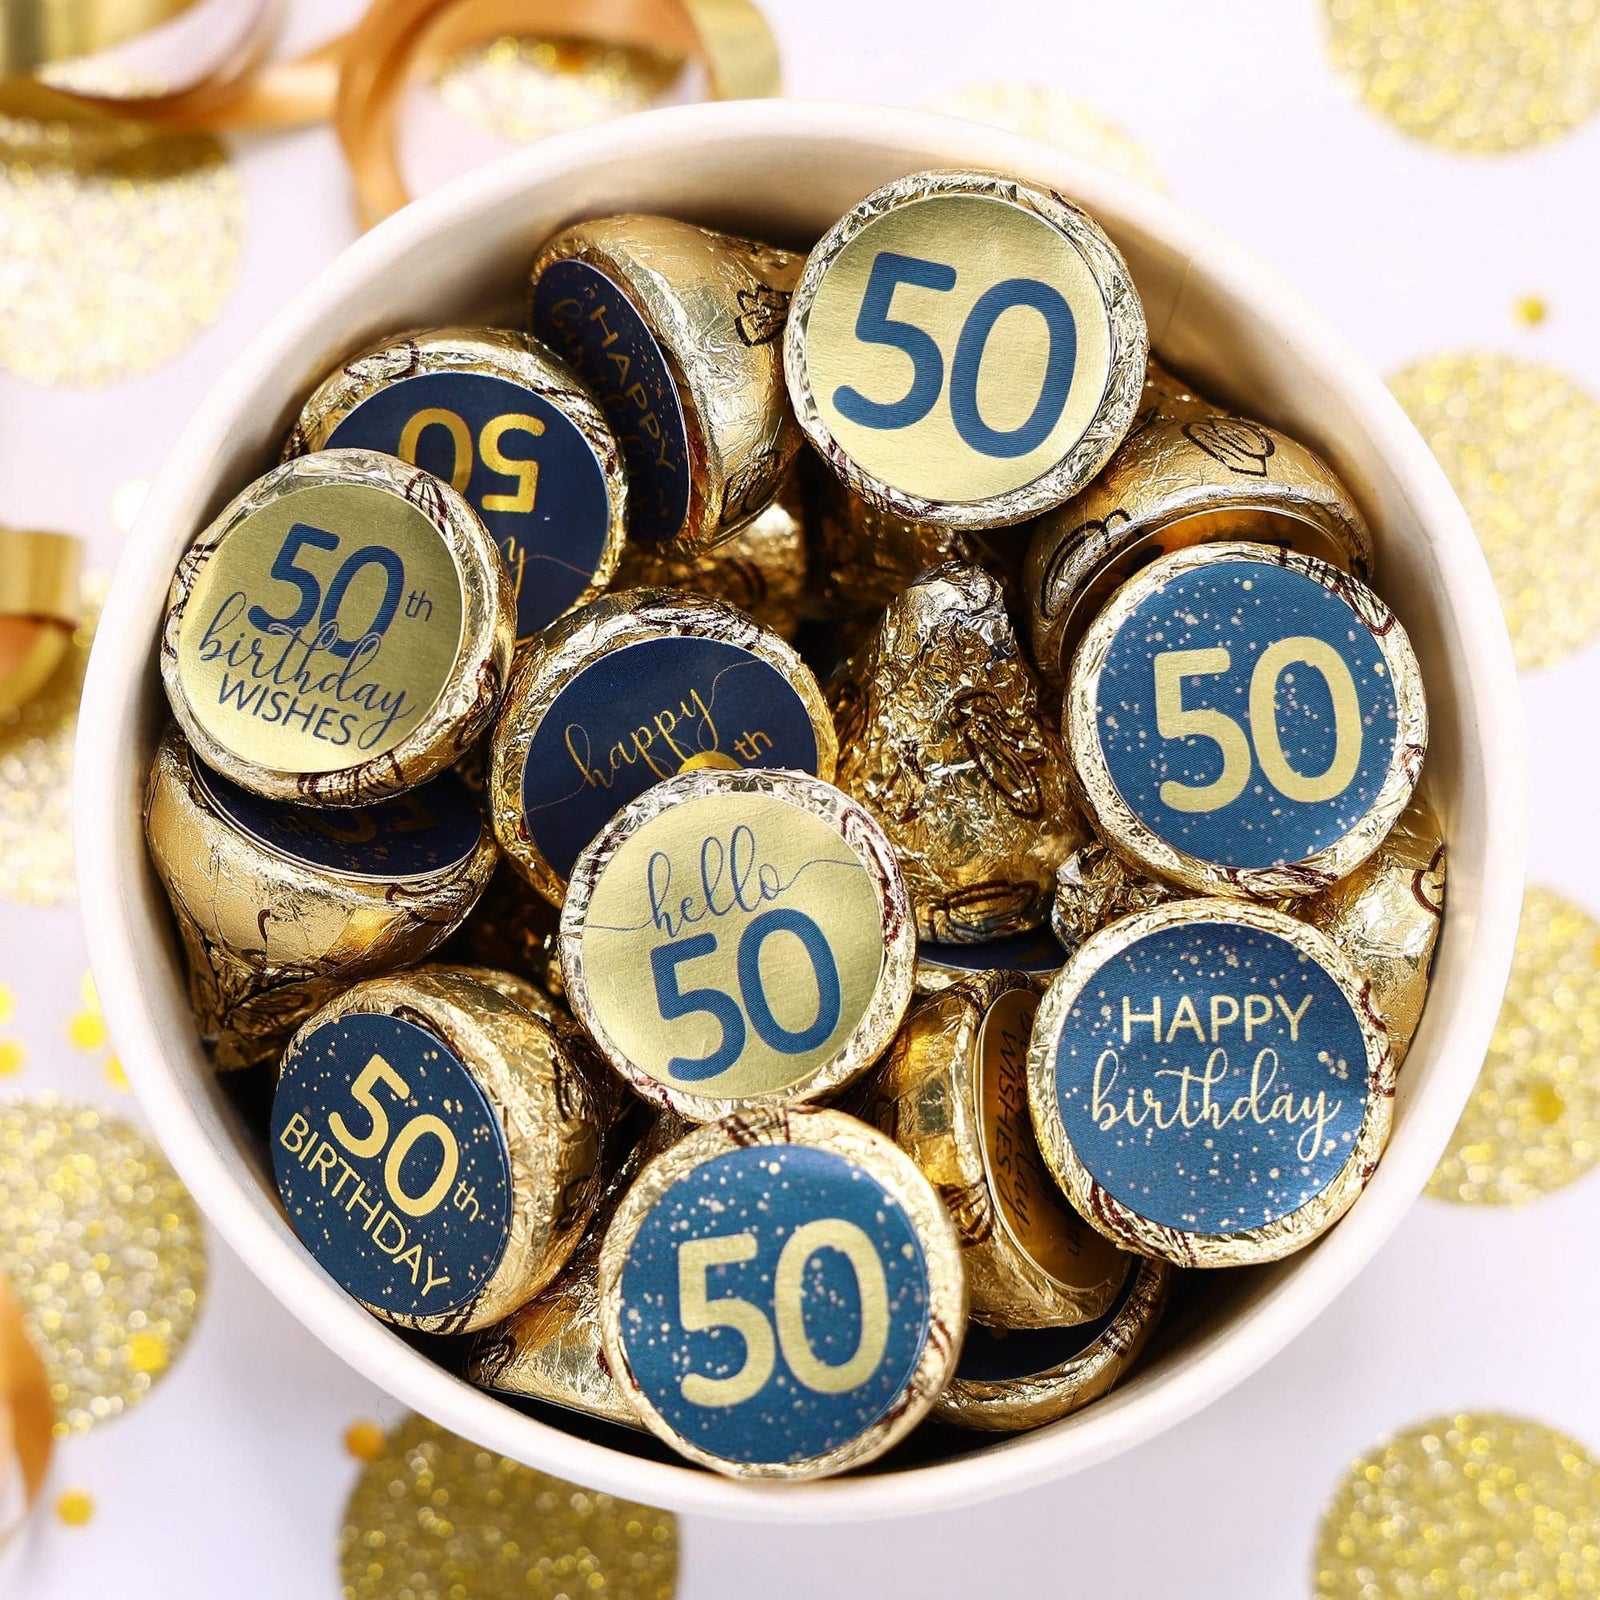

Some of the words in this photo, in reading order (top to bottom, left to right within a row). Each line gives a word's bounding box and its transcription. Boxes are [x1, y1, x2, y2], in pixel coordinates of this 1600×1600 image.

[589, 304, 677, 472] HAPPY
[832, 251, 1077, 459] 50
[198, 590, 417, 750] birthday
[218, 674, 362, 746] WISHES
[553, 677, 730, 797] happy
[1154, 636, 1363, 812] 50
[632, 823, 805, 938] hello
[650, 907, 842, 1082] 50
[1121, 994, 1314, 1044] HAPPY
[996, 1030, 1018, 1176] WISHES
[1091, 1047, 1342, 1162] birthday
[279, 1112, 450, 1297] BIRTHDAY
[678, 1218, 891, 1408] 50
